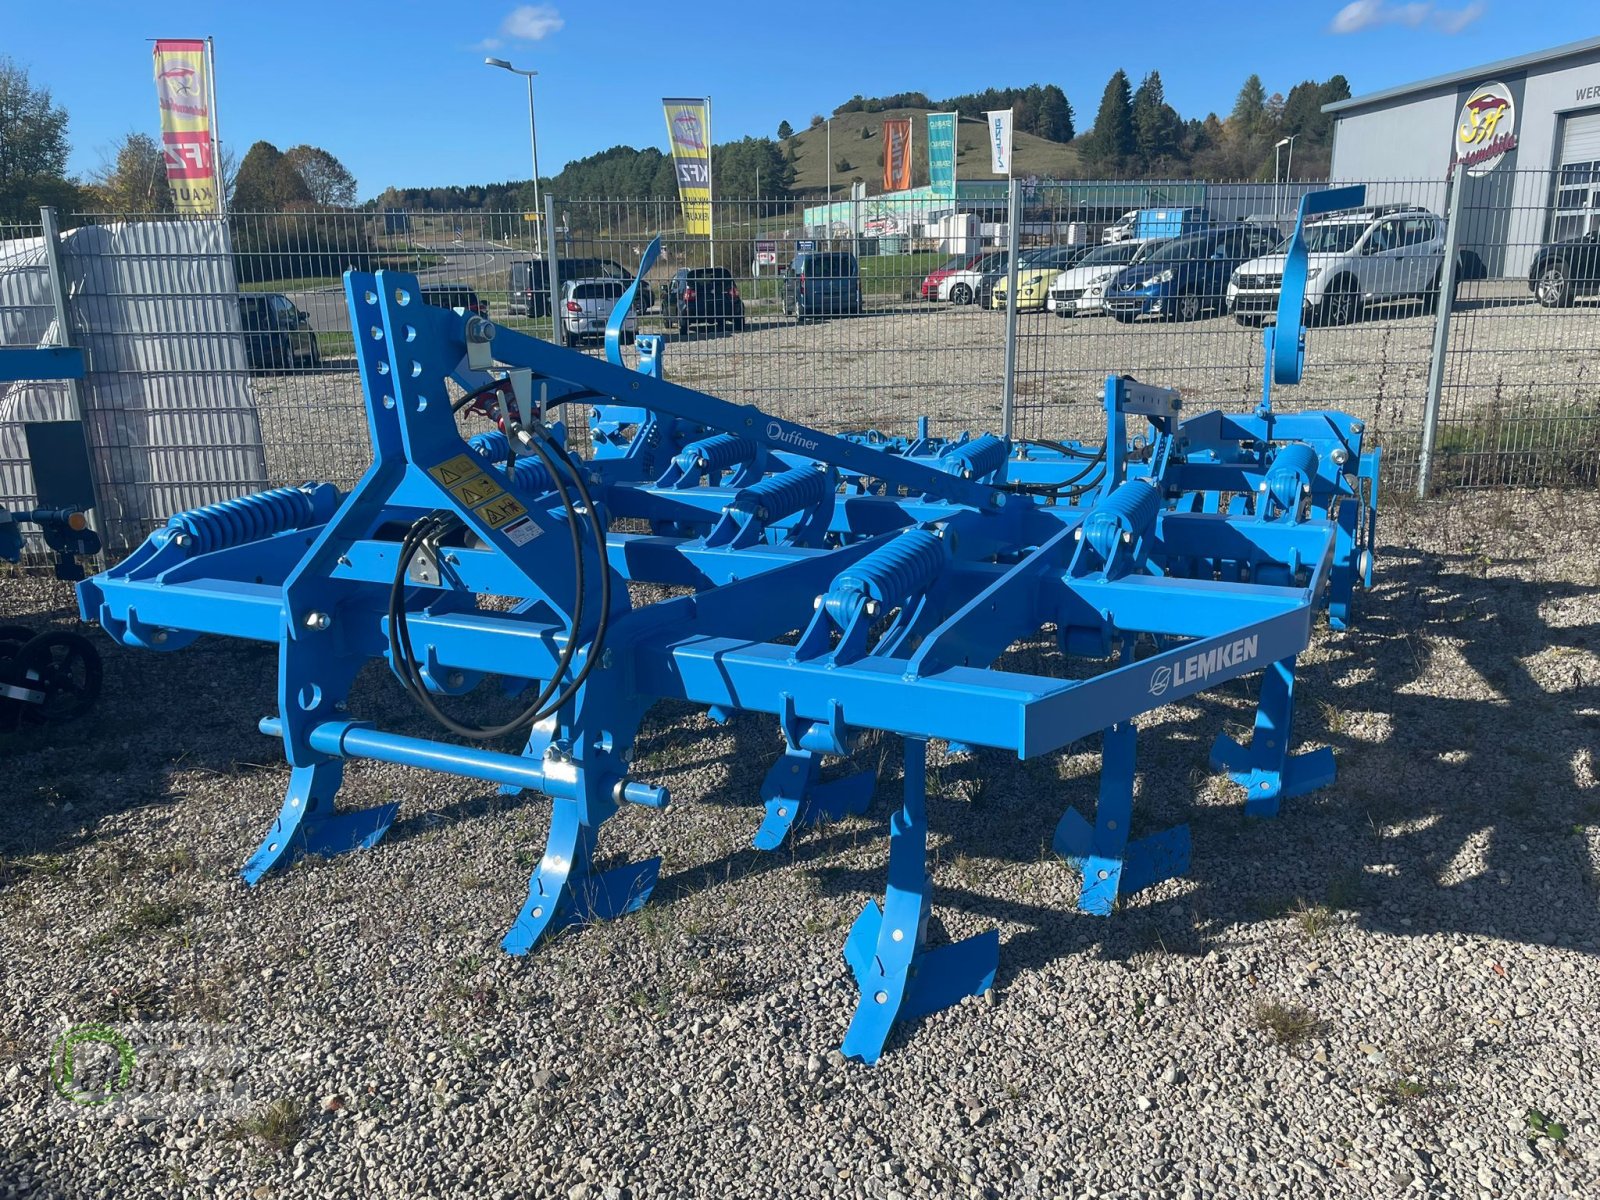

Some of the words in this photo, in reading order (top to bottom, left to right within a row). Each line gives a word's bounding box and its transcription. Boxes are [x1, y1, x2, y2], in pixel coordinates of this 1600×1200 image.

[1576, 85, 1600, 101] WER
[766, 421, 819, 451] Duffner
[1173, 634, 1259, 688] LEMKEN
